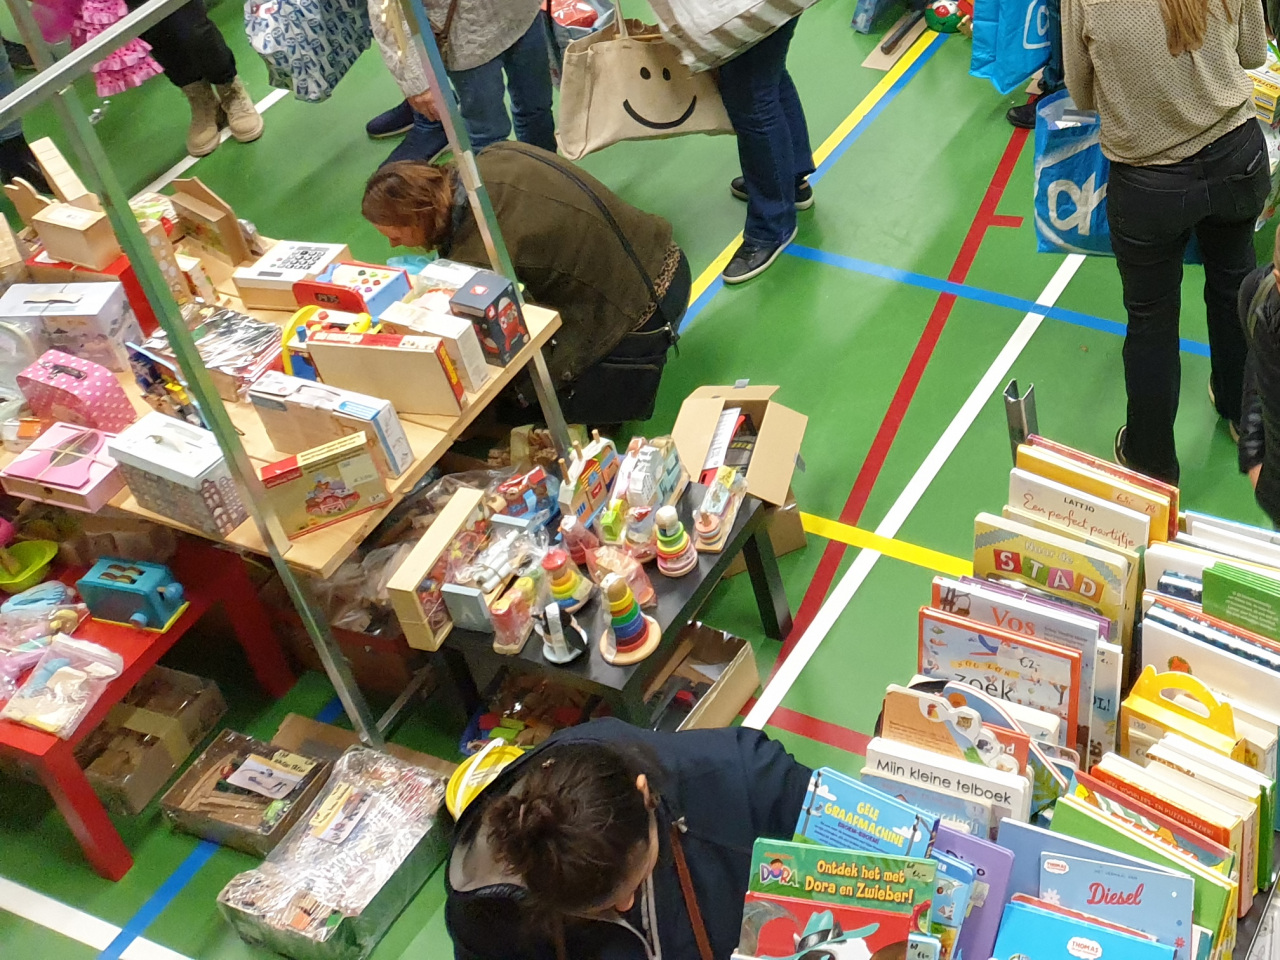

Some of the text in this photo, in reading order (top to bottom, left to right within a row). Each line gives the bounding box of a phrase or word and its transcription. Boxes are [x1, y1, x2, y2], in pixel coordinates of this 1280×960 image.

[1063, 497, 1095, 513] LATTJO
[1023, 493, 1135, 549] Een perfect partijtje
[1025, 541, 1074, 565] Naar de
[999, 551, 1097, 596] STAD
[990, 605, 1037, 636] Vos
[954, 673, 1014, 703] zoek
[876, 758, 1012, 805] Mijn kleine telboek
[823, 802, 906, 848] GRAAFMACHINE
[856, 802, 880, 821] GELE
[760, 861, 799, 888] DORA
[816, 859, 905, 884] Ontdek het met
[805, 876, 914, 904] Dora en Zwieber!
[1086, 882, 1145, 906] Diesel
[1071, 940, 1099, 954] THOMAS
